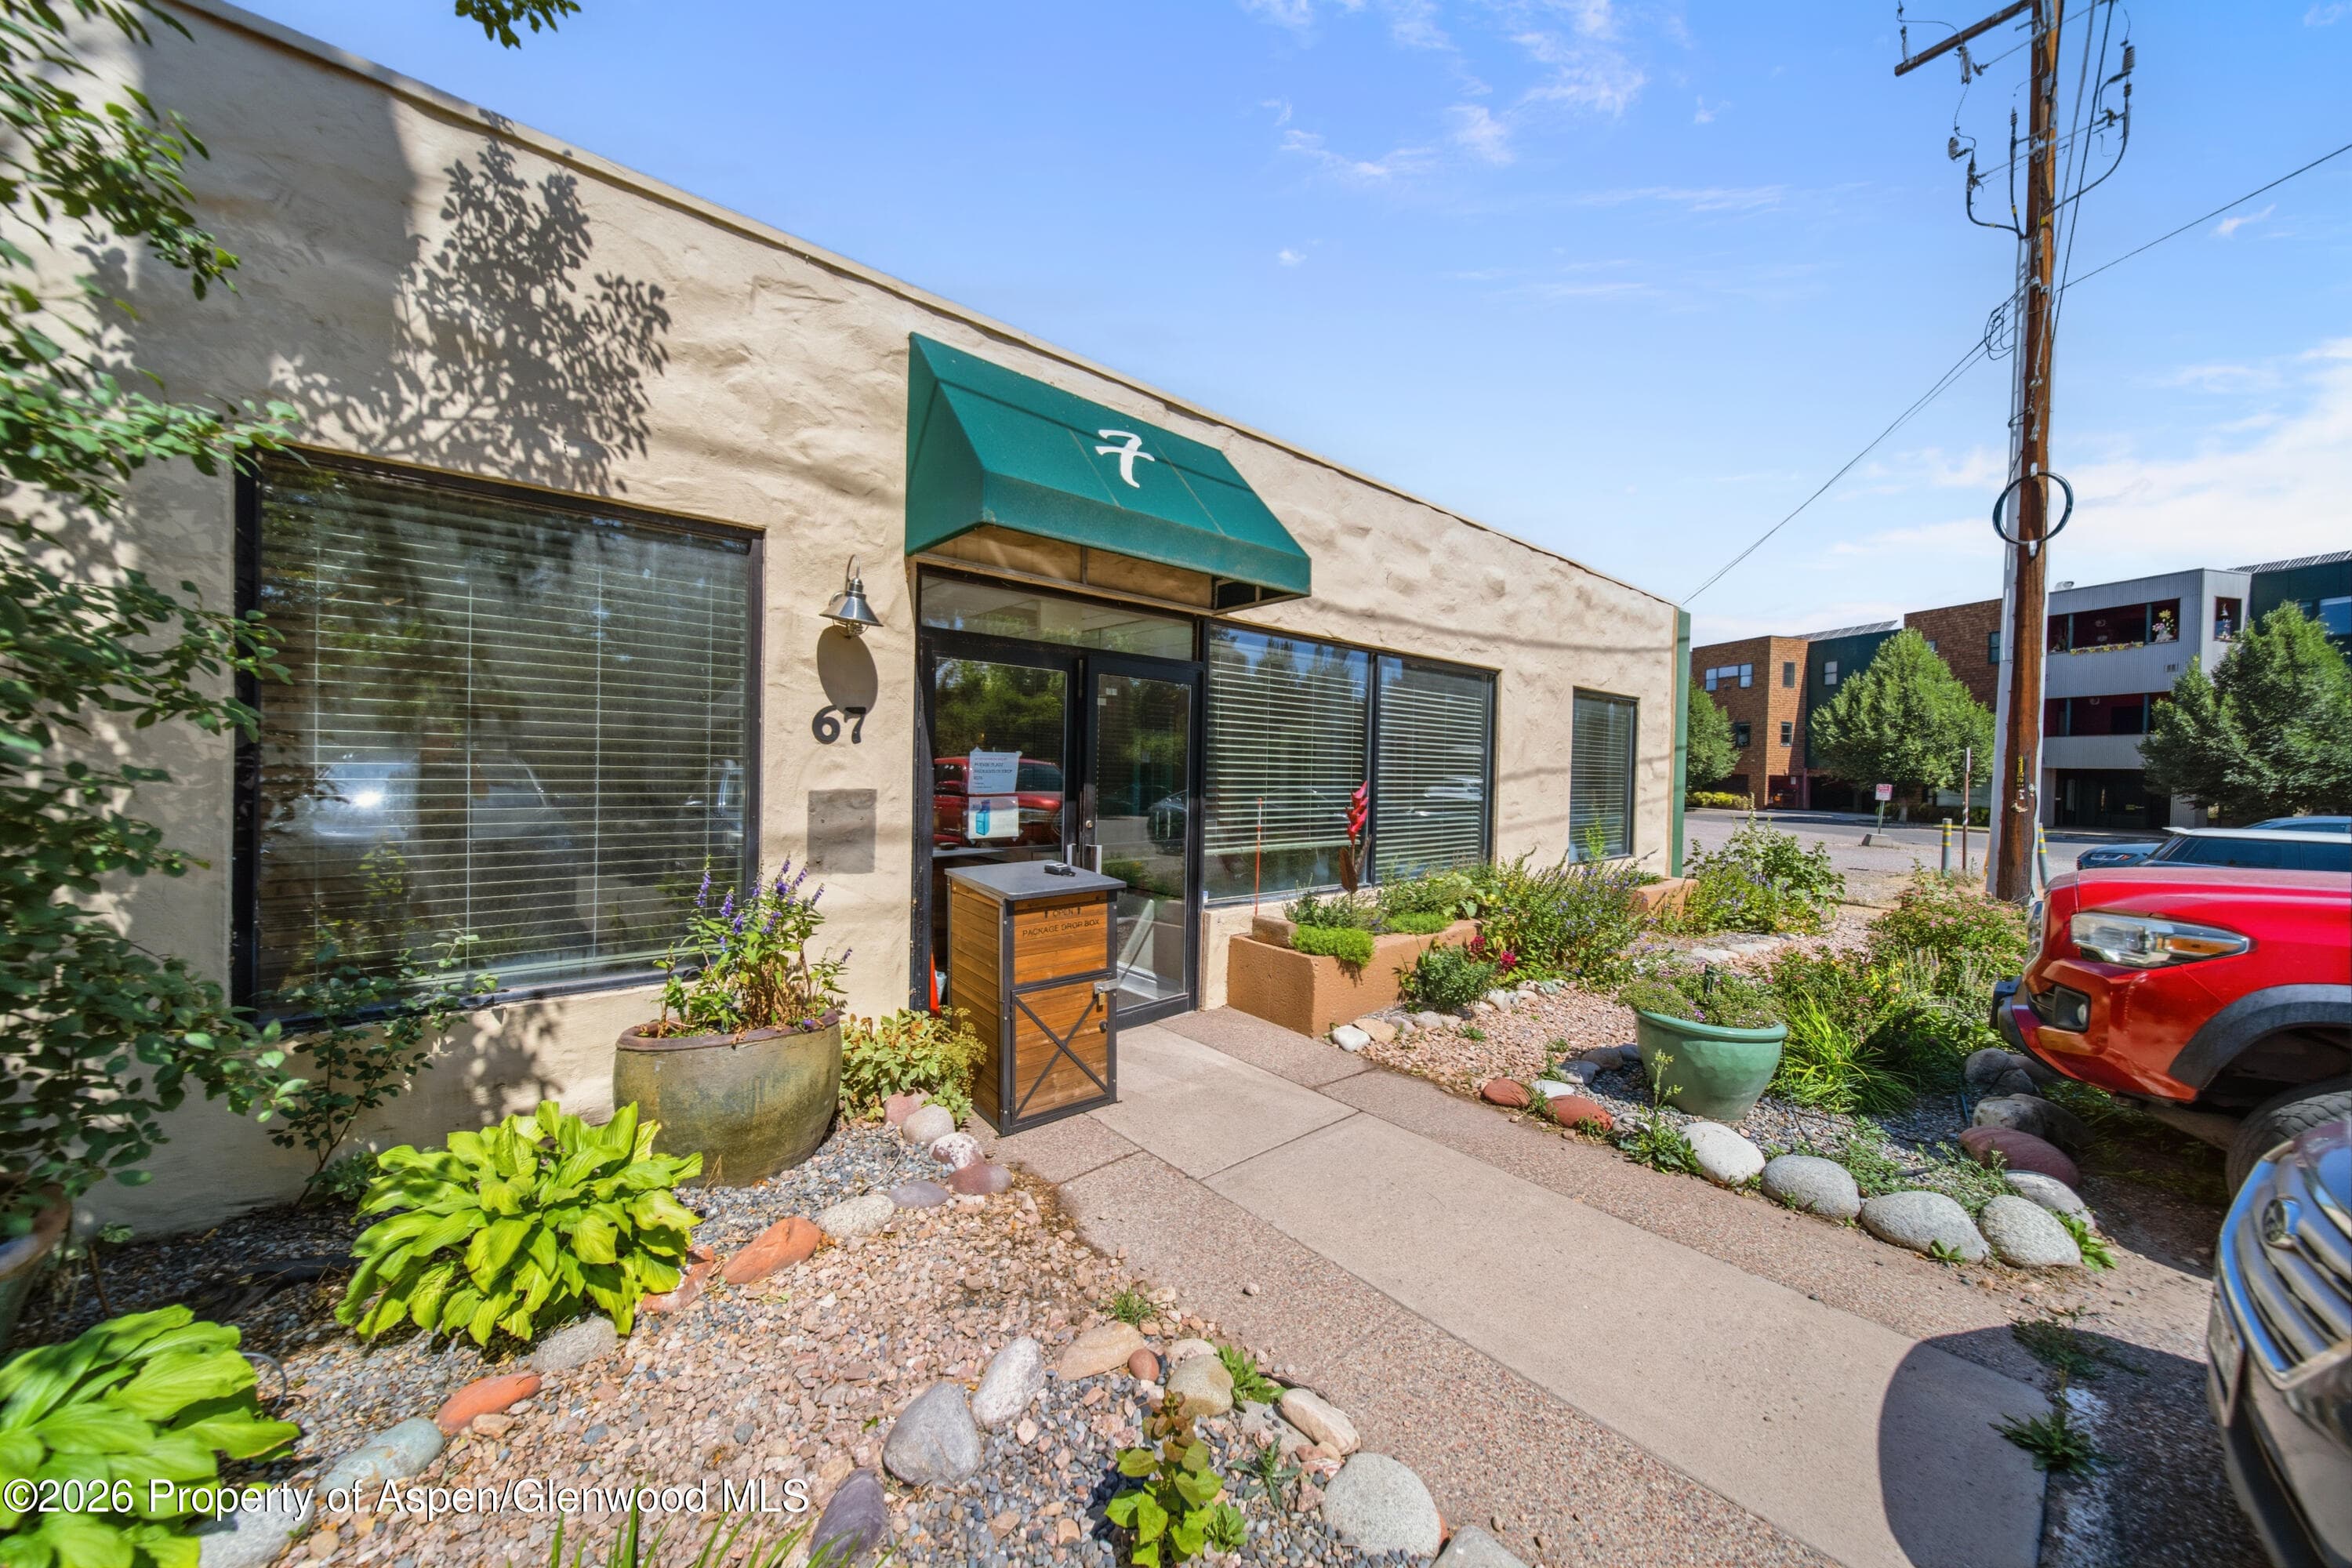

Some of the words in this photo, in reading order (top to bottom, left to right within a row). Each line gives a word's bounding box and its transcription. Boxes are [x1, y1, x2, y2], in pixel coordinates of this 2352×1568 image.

[812, 705, 866, 745] 67
[1052, 909, 1073, 917] OPEN
[1022, 924, 1058, 937] PACKAGE
[1061, 920, 1083, 931] DROP
[1084, 918, 1099, 927] BOX
